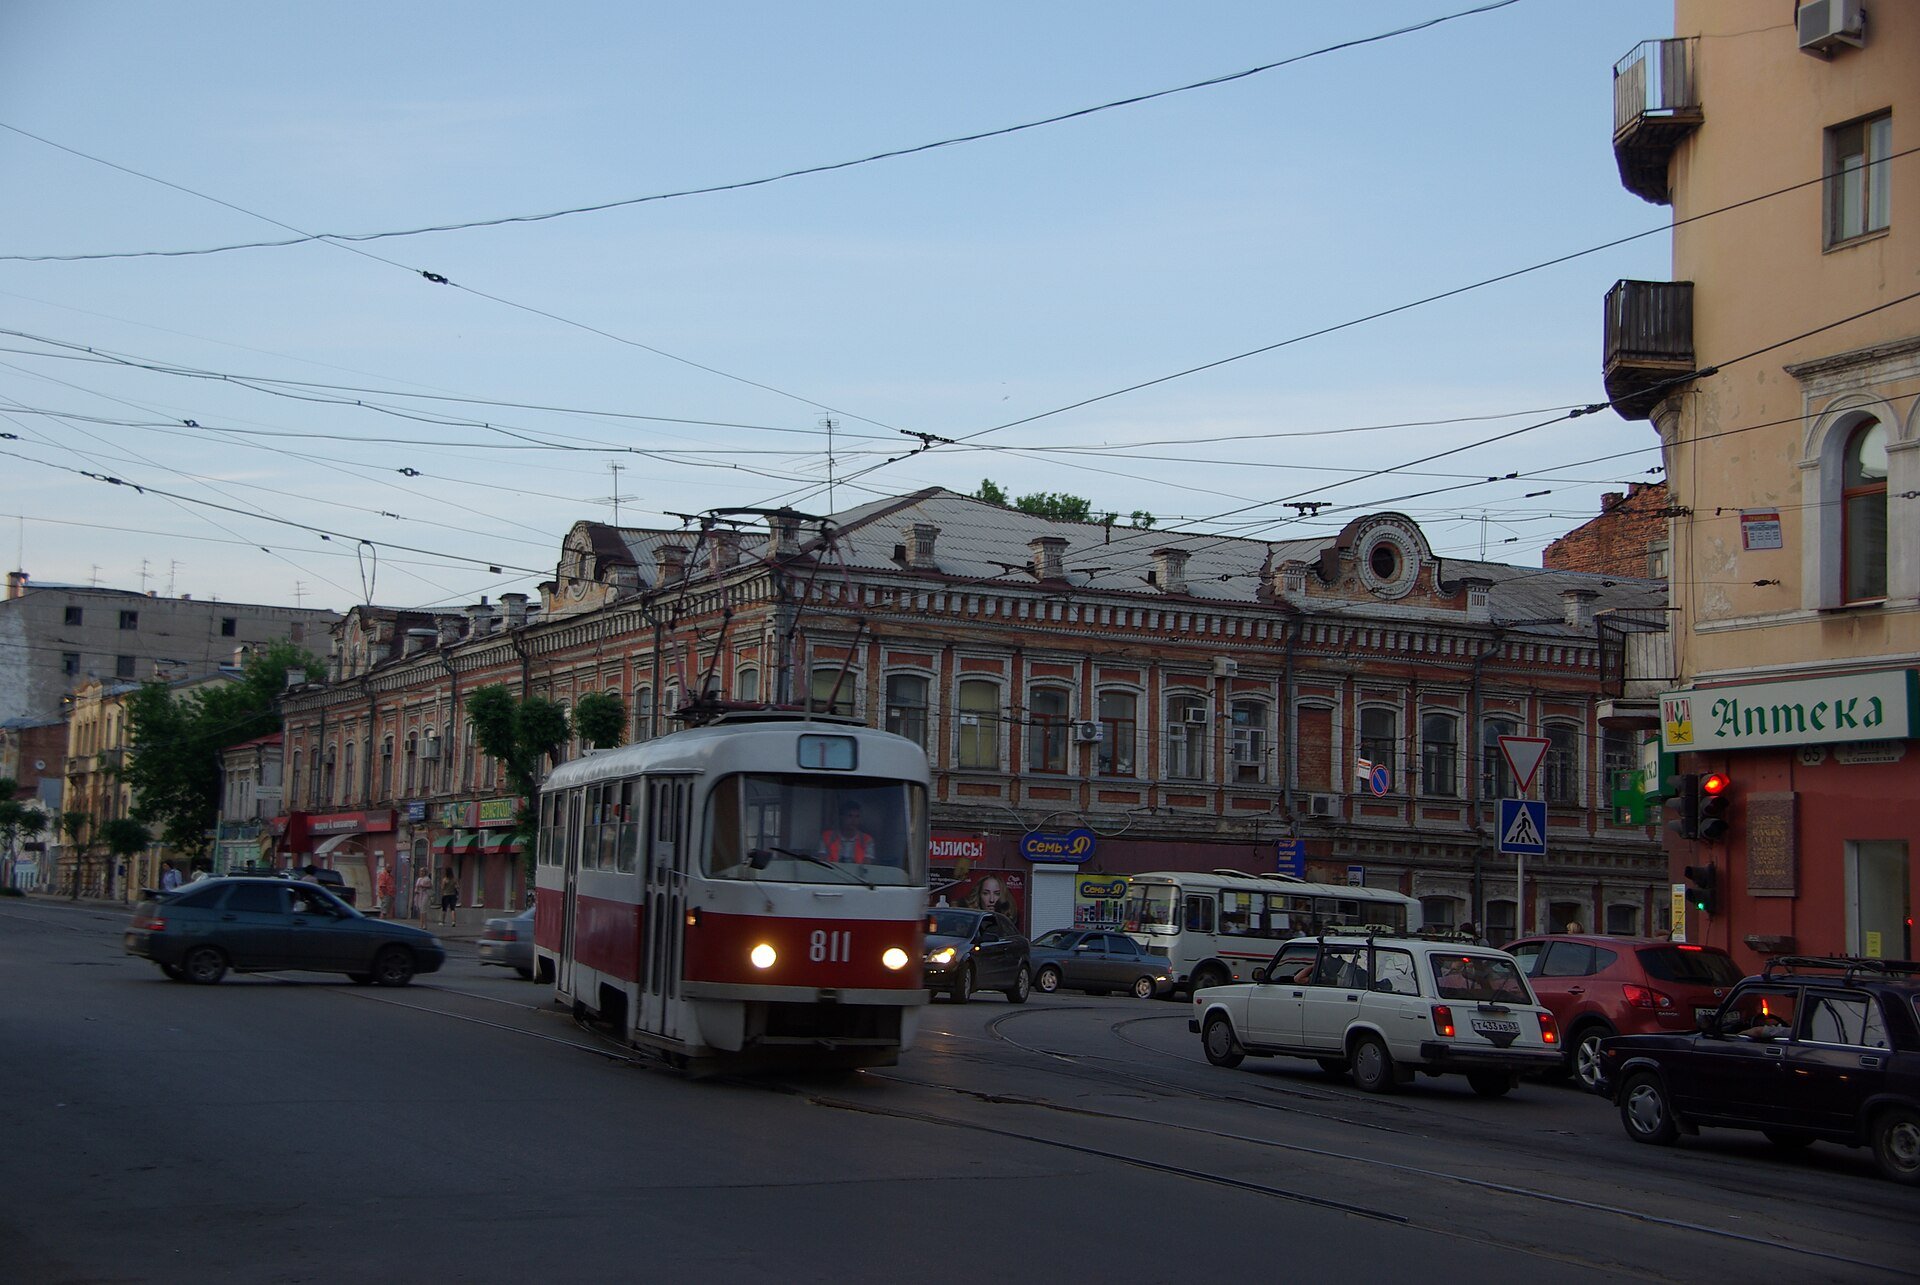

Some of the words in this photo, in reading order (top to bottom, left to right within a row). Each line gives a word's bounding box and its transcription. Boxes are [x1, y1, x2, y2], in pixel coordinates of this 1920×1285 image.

[1711, 695, 1882, 739] Аптека
[1803, 746, 1820, 762] 65
[809, 929, 851, 962] 811
